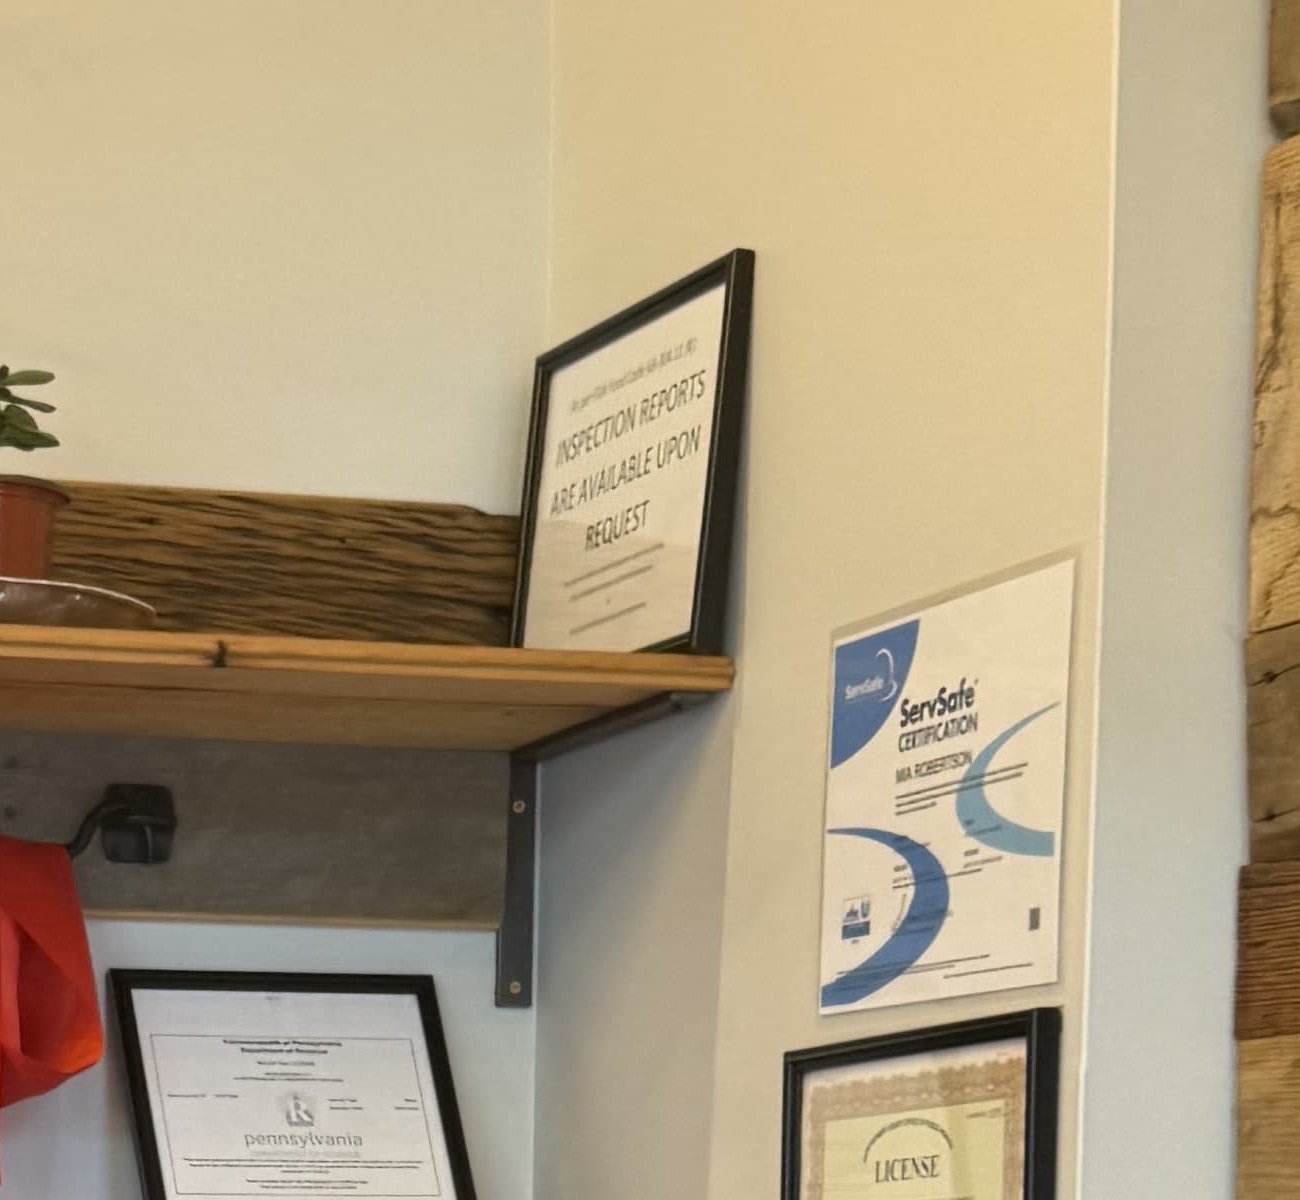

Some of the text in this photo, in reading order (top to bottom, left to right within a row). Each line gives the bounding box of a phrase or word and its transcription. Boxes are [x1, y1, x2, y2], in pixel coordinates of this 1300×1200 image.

[555, 402, 637, 468] INSPECTION
[638, 369, 706, 427] REPORTS
[550, 423, 701, 516] ARE AVAILABLE UPON
[584, 499, 651, 552] REQUEST
[899, 677, 975, 728] ServSafe
[897, 711, 979, 753] CERTIFICATION
[244, 1129, 364, 1149] pennsylvania
[874, 1154, 941, 1184] LICENSE
